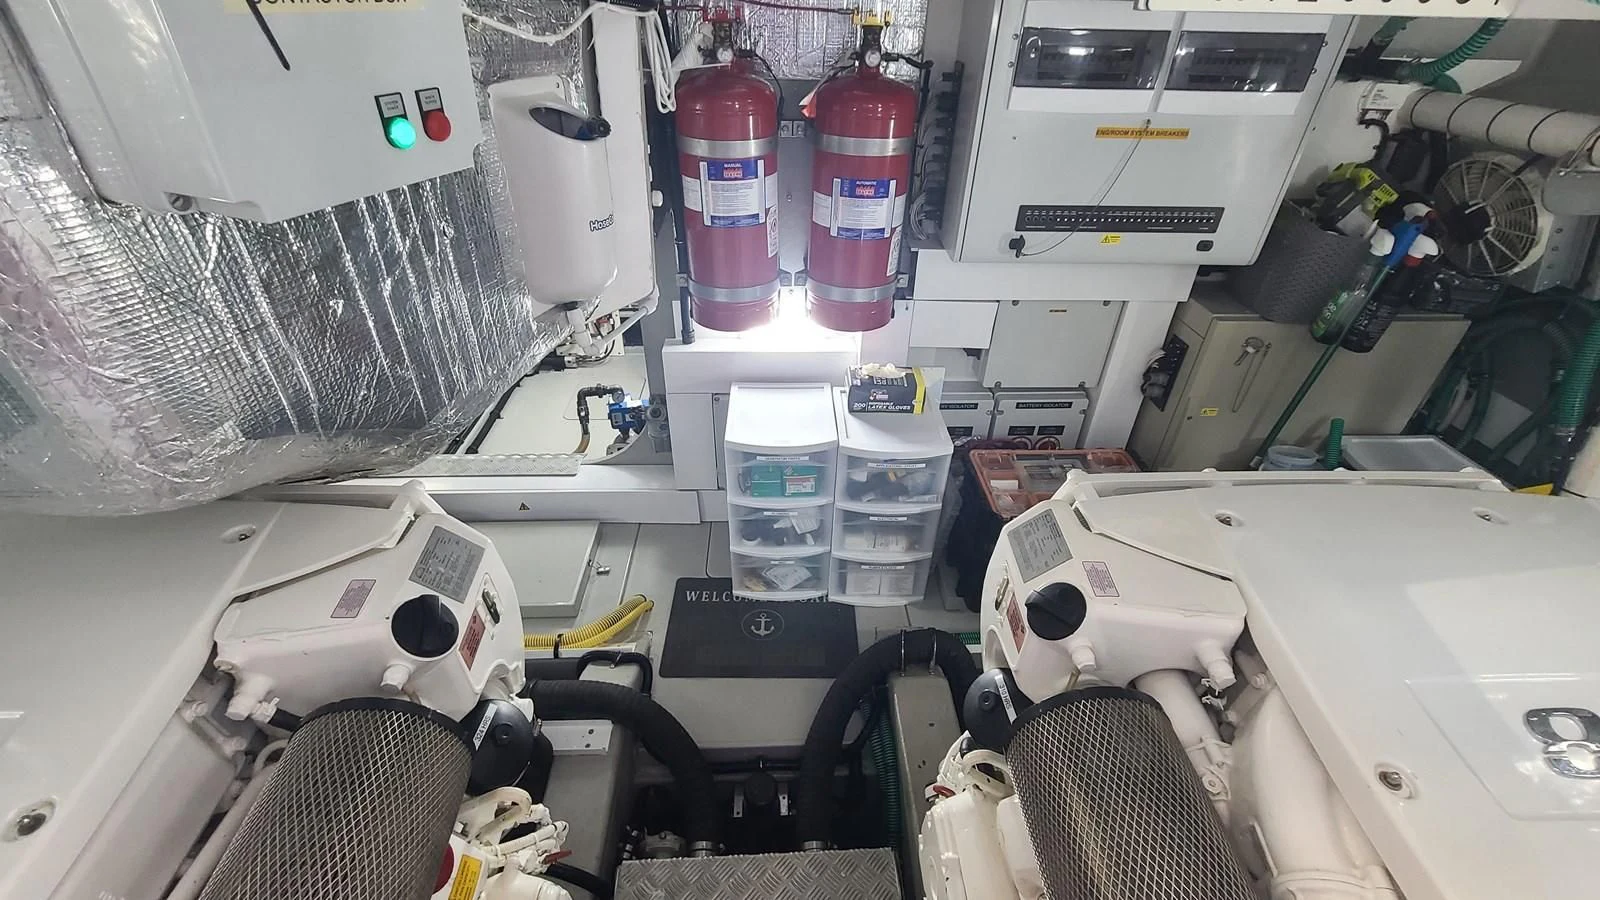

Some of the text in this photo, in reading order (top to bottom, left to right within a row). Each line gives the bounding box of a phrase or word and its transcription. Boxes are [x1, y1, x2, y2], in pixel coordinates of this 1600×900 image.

[1002, 695, 1012, 710] HRS
[474, 714, 492, 741] 324 HRS
